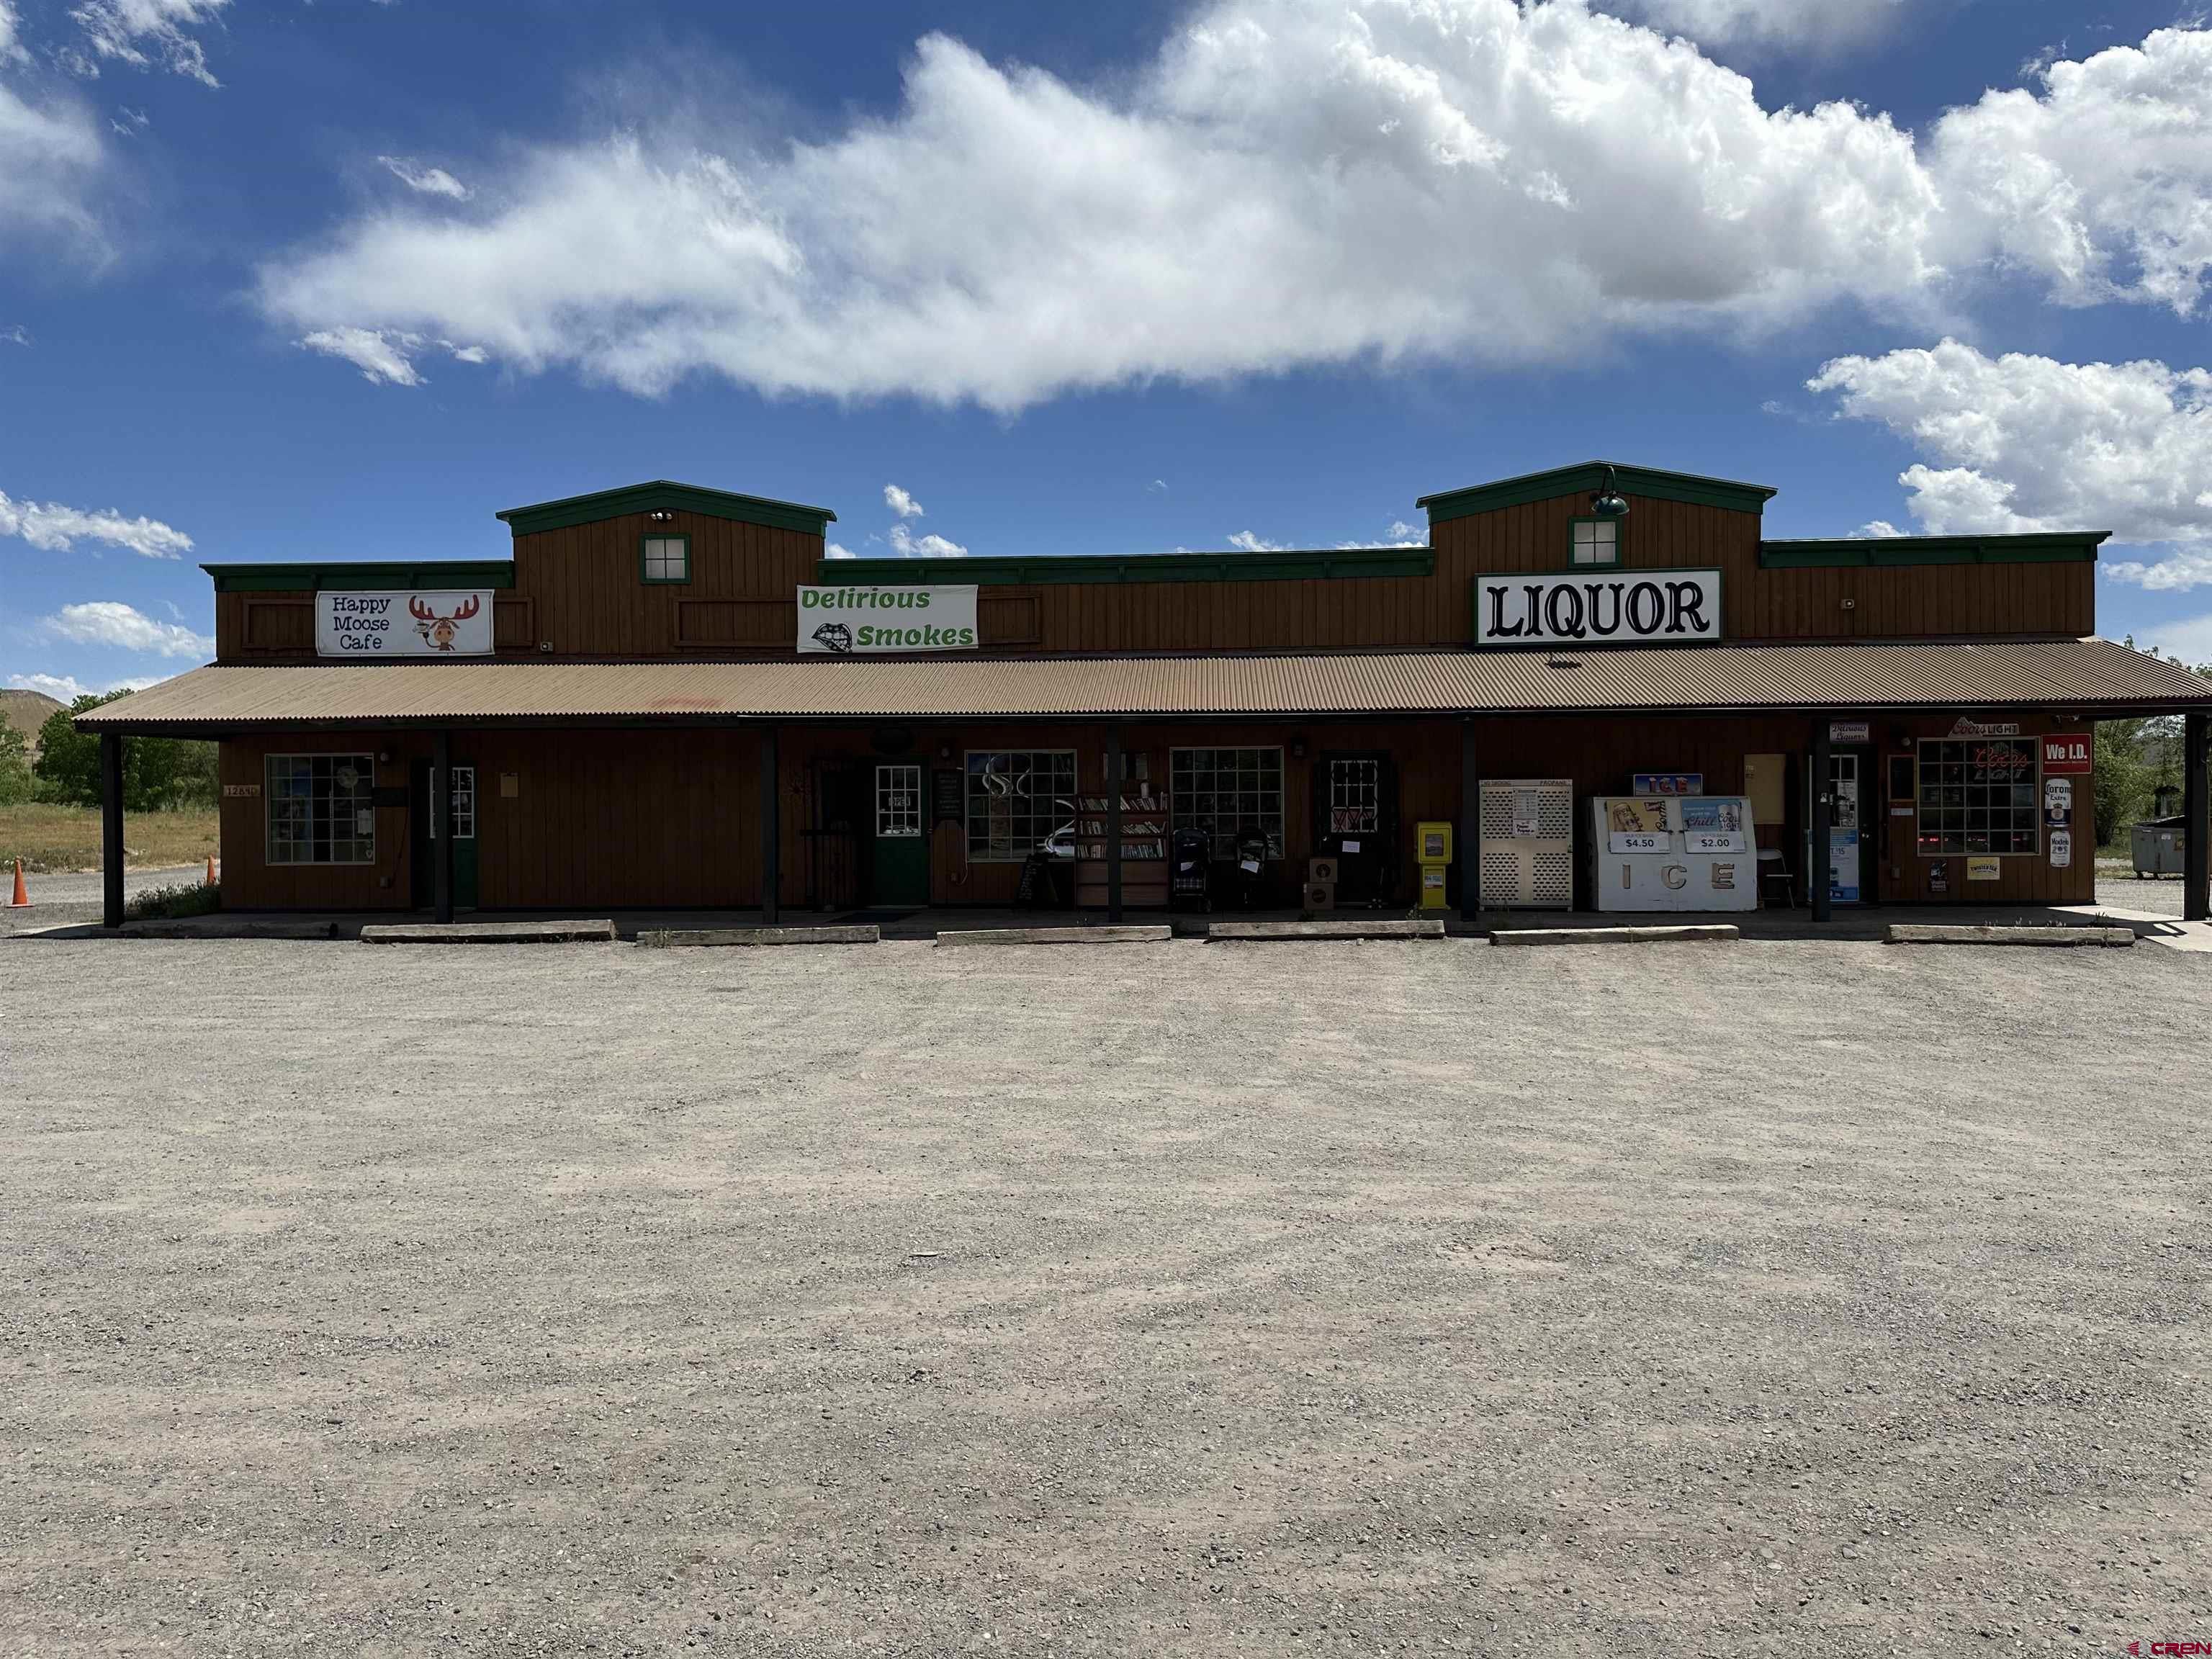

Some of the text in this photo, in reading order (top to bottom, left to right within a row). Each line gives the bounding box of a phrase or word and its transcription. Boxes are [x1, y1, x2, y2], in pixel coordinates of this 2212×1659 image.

[332, 597, 391, 614] Happy
[801, 587, 930, 609] Delirious
[1486, 581, 1710, 639] LIQUOR
[333, 616, 390, 631] Moose
[340, 634, 382, 650] Cafe
[856, 624, 974, 647] Smokes
[1987, 724, 2018, 734] LIGHT
[2046, 743, 2088, 760] We I.D.
[1648, 776, 1689, 793] ICE
[1625, 839, 1654, 848] $4.50
[1701, 839, 1730, 848] $2.00
[1622, 862, 1735, 891] ICE
